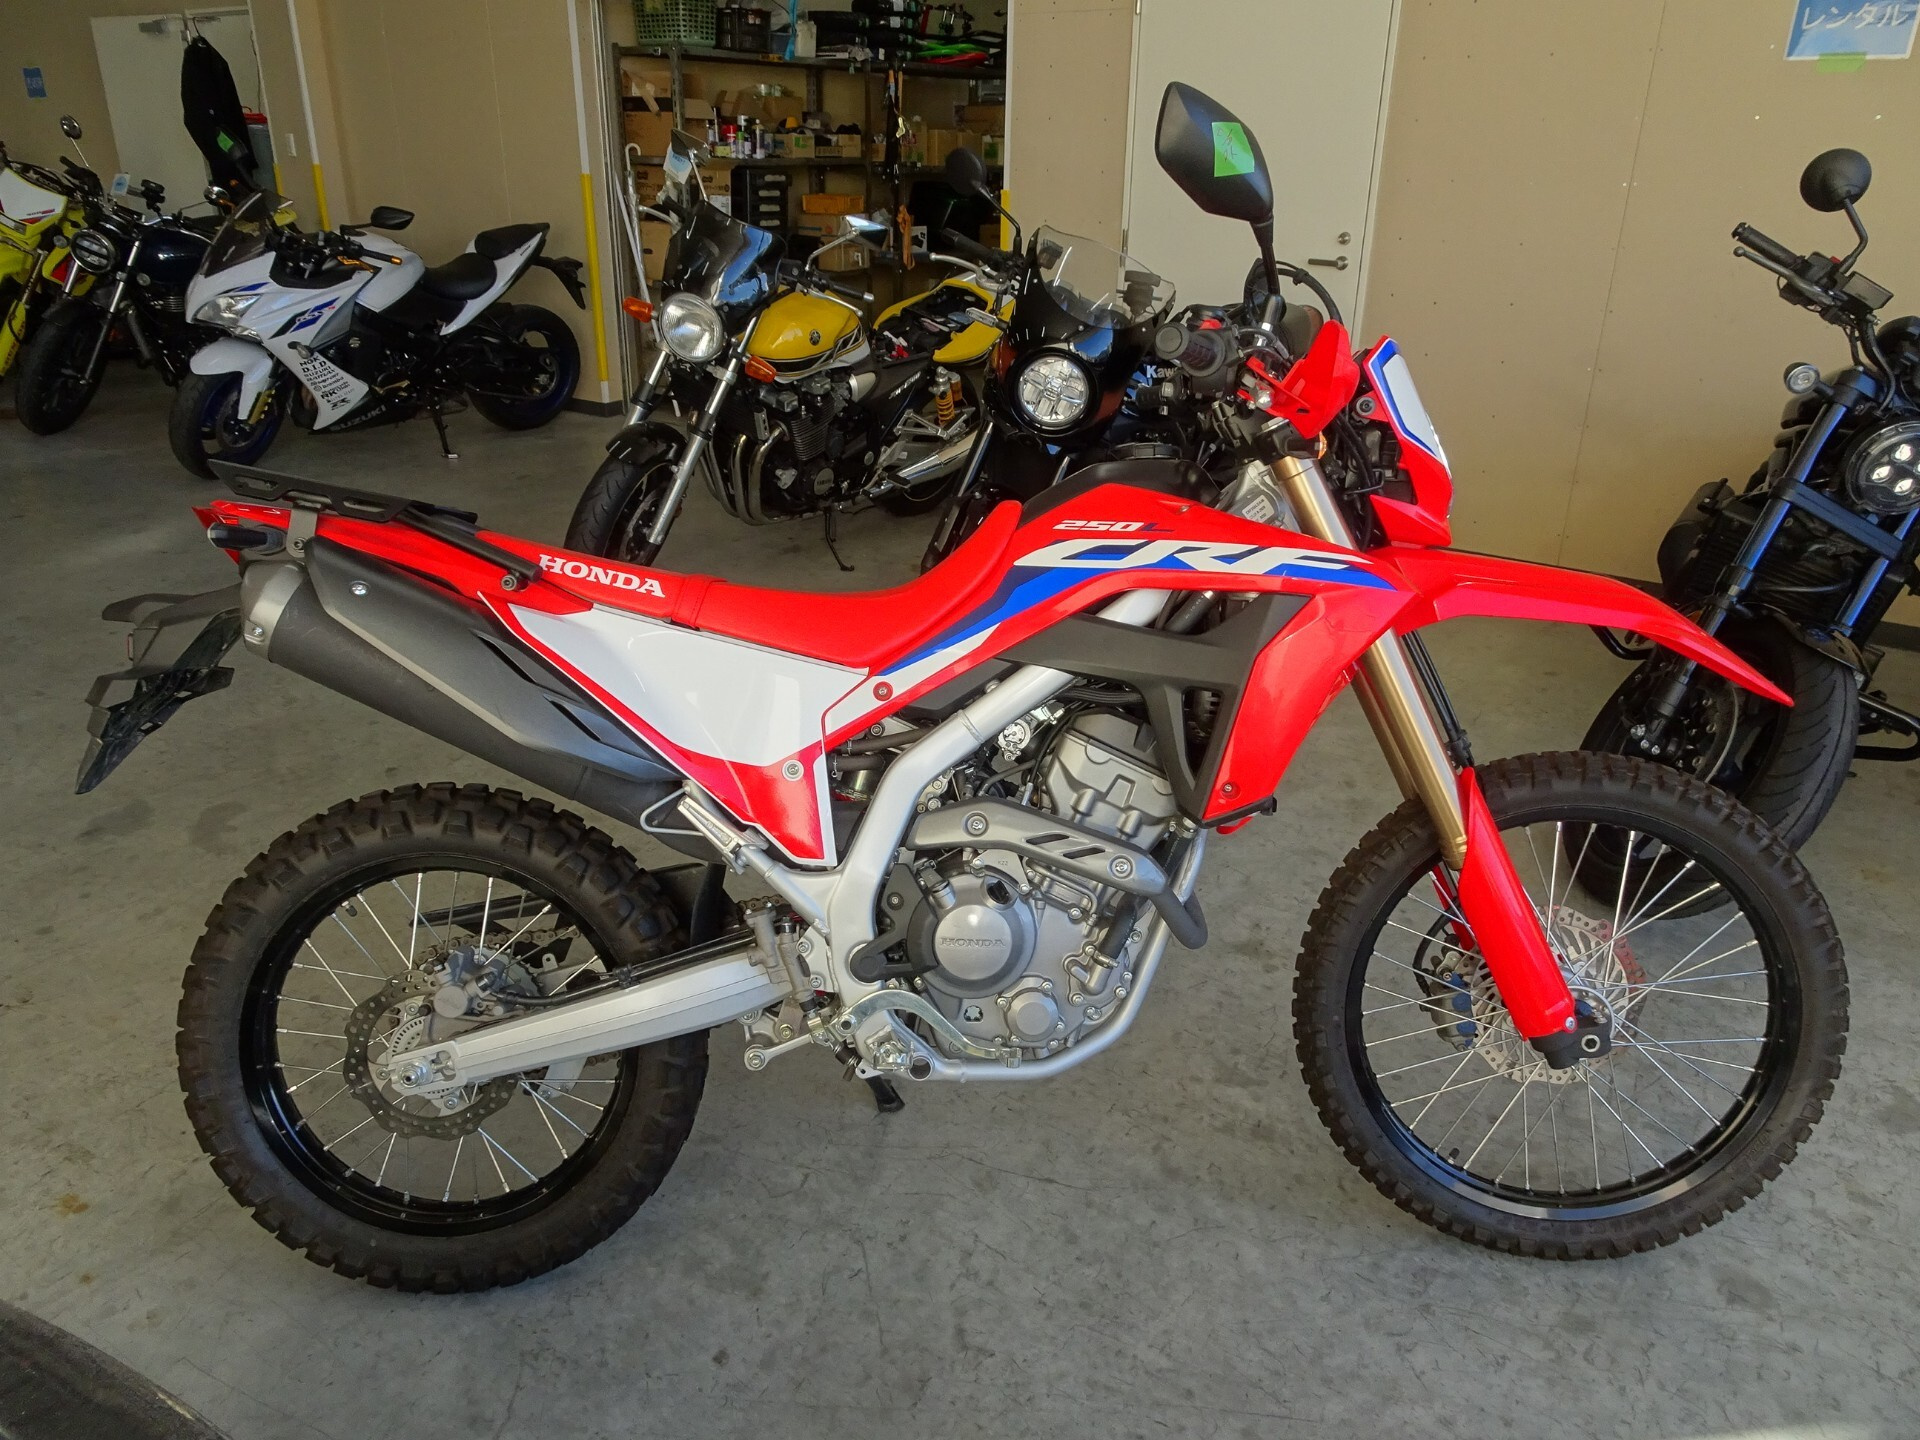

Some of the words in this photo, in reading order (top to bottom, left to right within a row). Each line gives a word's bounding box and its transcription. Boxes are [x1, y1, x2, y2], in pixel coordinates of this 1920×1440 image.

[1802, 2, 1909, 30] レンタル
[302, 360, 327, 373] D.I.D
[304, 365, 331, 377] SUZUKI
[330, 404, 387, 431] SUZUKI
[1052, 520, 1175, 532] 250L
[1013, 538, 1374, 575] CRF
[539, 554, 666, 598] HONDA
[940, 936, 1006, 947] HONDA
